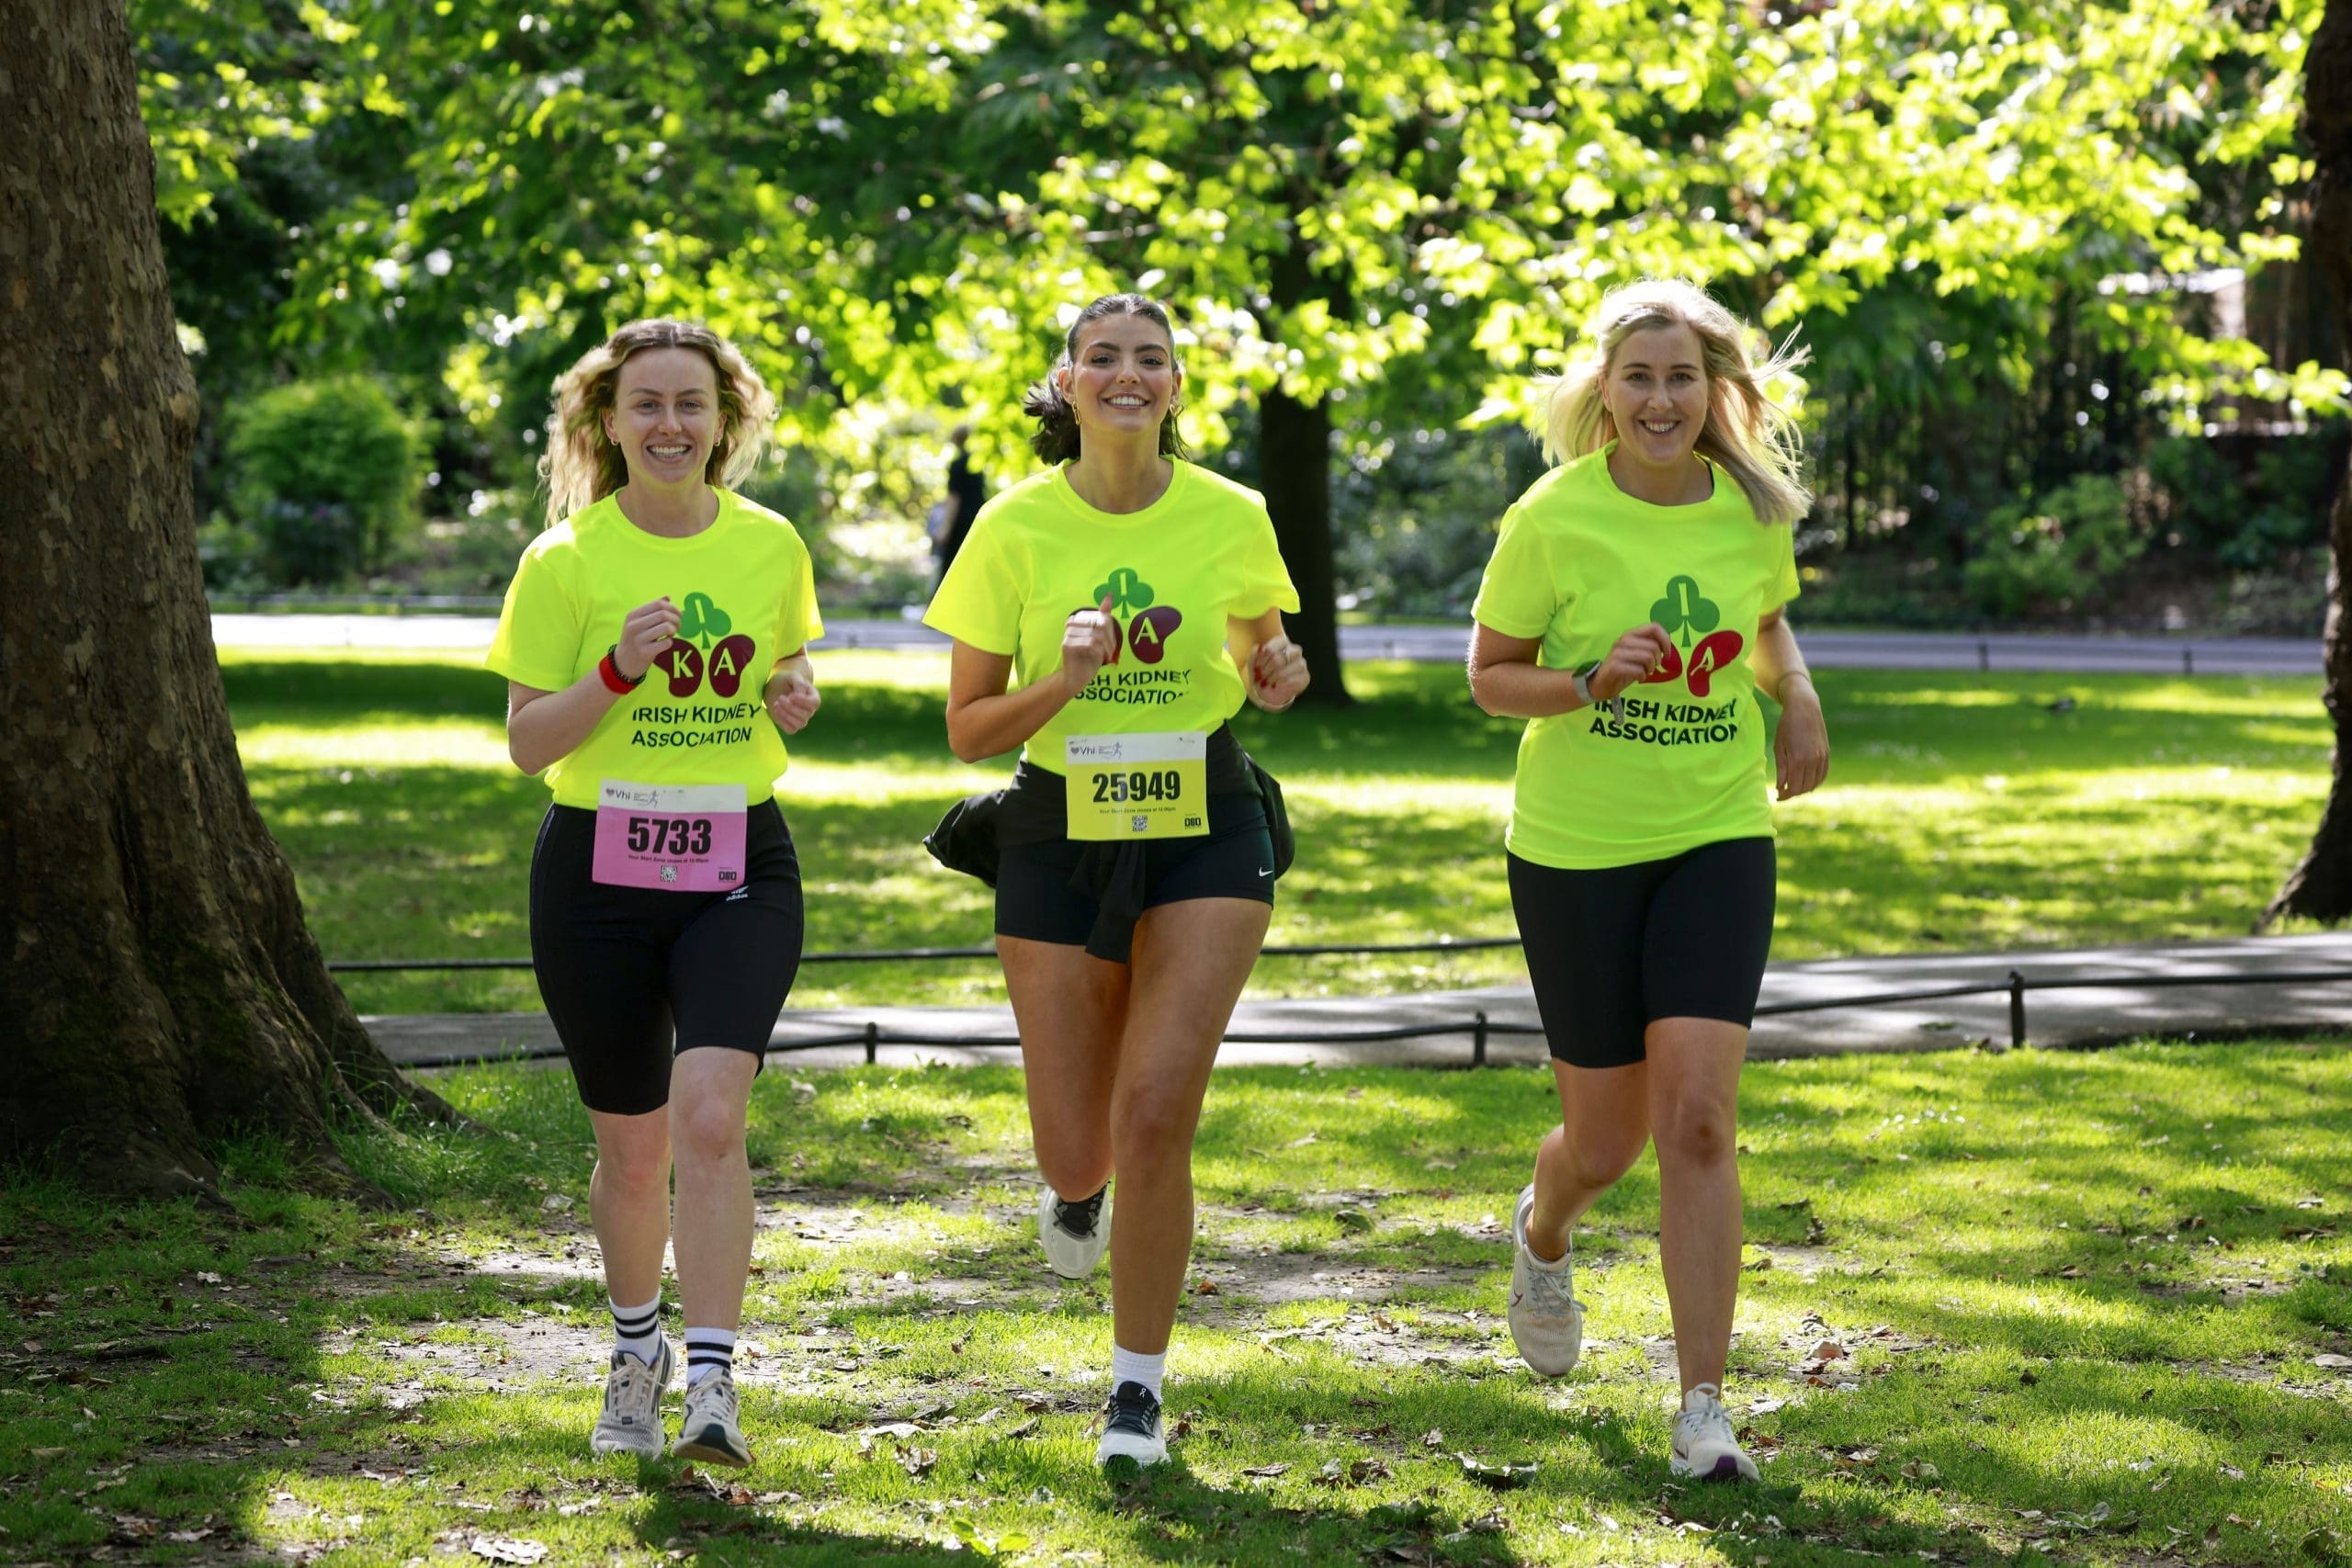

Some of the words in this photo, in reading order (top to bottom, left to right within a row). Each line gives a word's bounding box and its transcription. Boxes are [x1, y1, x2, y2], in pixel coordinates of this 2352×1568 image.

[1135, 616, 1159, 645] A
[673, 650, 695, 679] K
[714, 647, 737, 677] A
[1118, 669, 1193, 686] KIDNEY
[632, 706, 688, 724] IRISH
[693, 703, 762, 724] KIDNEY
[1665, 698, 1736, 723] KIDNEY
[632, 727, 752, 748] ASSOCIATION
[1092, 770, 1182, 804] 25949
[628, 817, 712, 856] 5733
